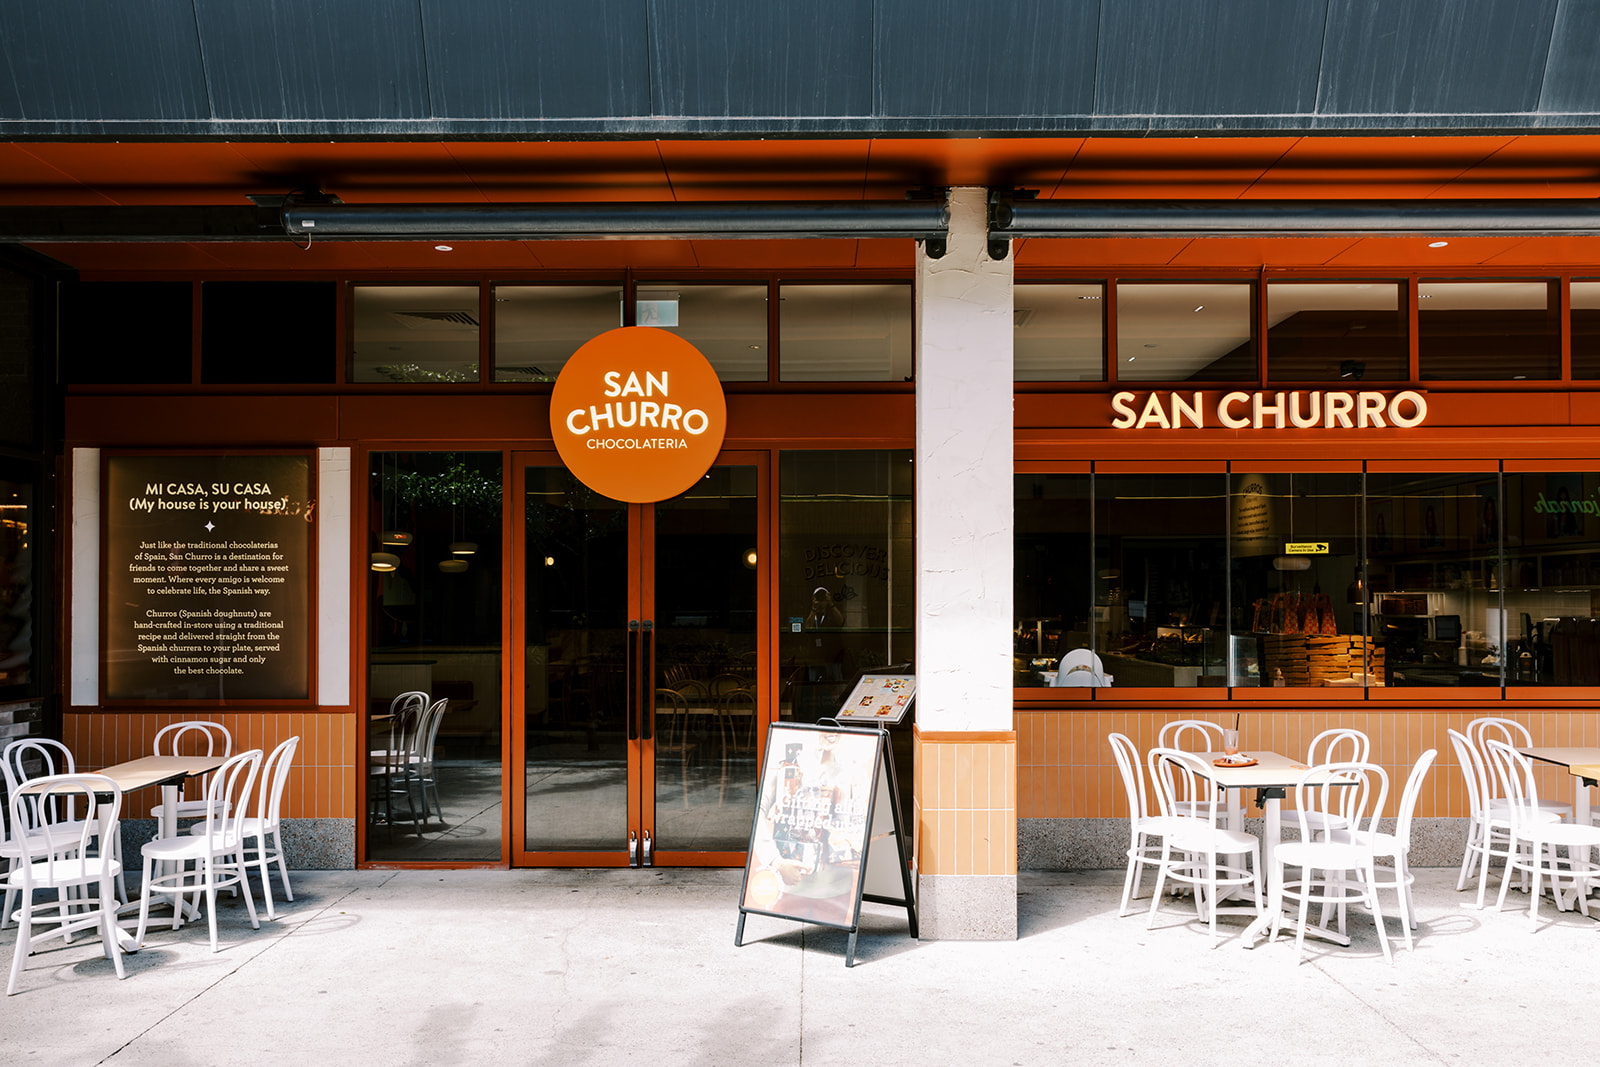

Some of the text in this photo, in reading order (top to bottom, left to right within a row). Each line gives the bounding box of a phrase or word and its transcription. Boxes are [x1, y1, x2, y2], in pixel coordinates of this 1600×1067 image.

[604, 371, 668, 397] SAN
[1111, 390, 1427, 429] SAN CHURRO
[566, 401, 708, 435] CHURRO
[586, 438, 688, 449] CHOCOLATERIA
[146, 483, 271, 498] MI CASA, SU CASA
[129, 498, 154, 514] (My
[157, 498, 196, 510] house
[199, 498, 209, 510] is
[212, 501, 241, 514] your
[244, 498, 286, 512] house)
[140, 541, 279, 549] Just like the traditional chocolaterias
[134, 552, 143, 560] of
[144, 552, 168, 562] Spain,
[169, 552, 183, 560] San
[185, 552, 213, 560] Churro
[228, 552, 271, 560] destination
[272, 552, 284, 560] for
[802, 543, 888, 563] DISCOVER
[129, 564, 156, 572] friends
[189, 564, 222, 573] together
[223, 564, 238, 572] and
[239, 564, 259, 572] share
[801, 560, 889, 580] DELICIOUS
[168, 575, 194, 583] Where
[218, 576, 242, 584] amigo
[251, 575, 285, 583] welcome
[156, 586, 192, 594] celebrate
[193, 586, 207, 595] life,
[208, 586, 221, 594] the
[223, 586, 253, 596] Spanish
[254, 588, 271, 596] way.
[146, 609, 177, 617] Churros
[178, 609, 212, 619] (Spanish
[214, 609, 258, 619] doughnuts)
[214, 622, 236, 630] using
[138, 632, 280, 641] recipe and delivered straight from the
[137, 643, 168, 653] Spanish
[169, 643, 202, 651] churrera
[232, 643, 253, 653] plate,
[254, 643, 280, 651] served
[249, 655, 266, 664] only
[174, 666, 244, 674] the best chocolate.
